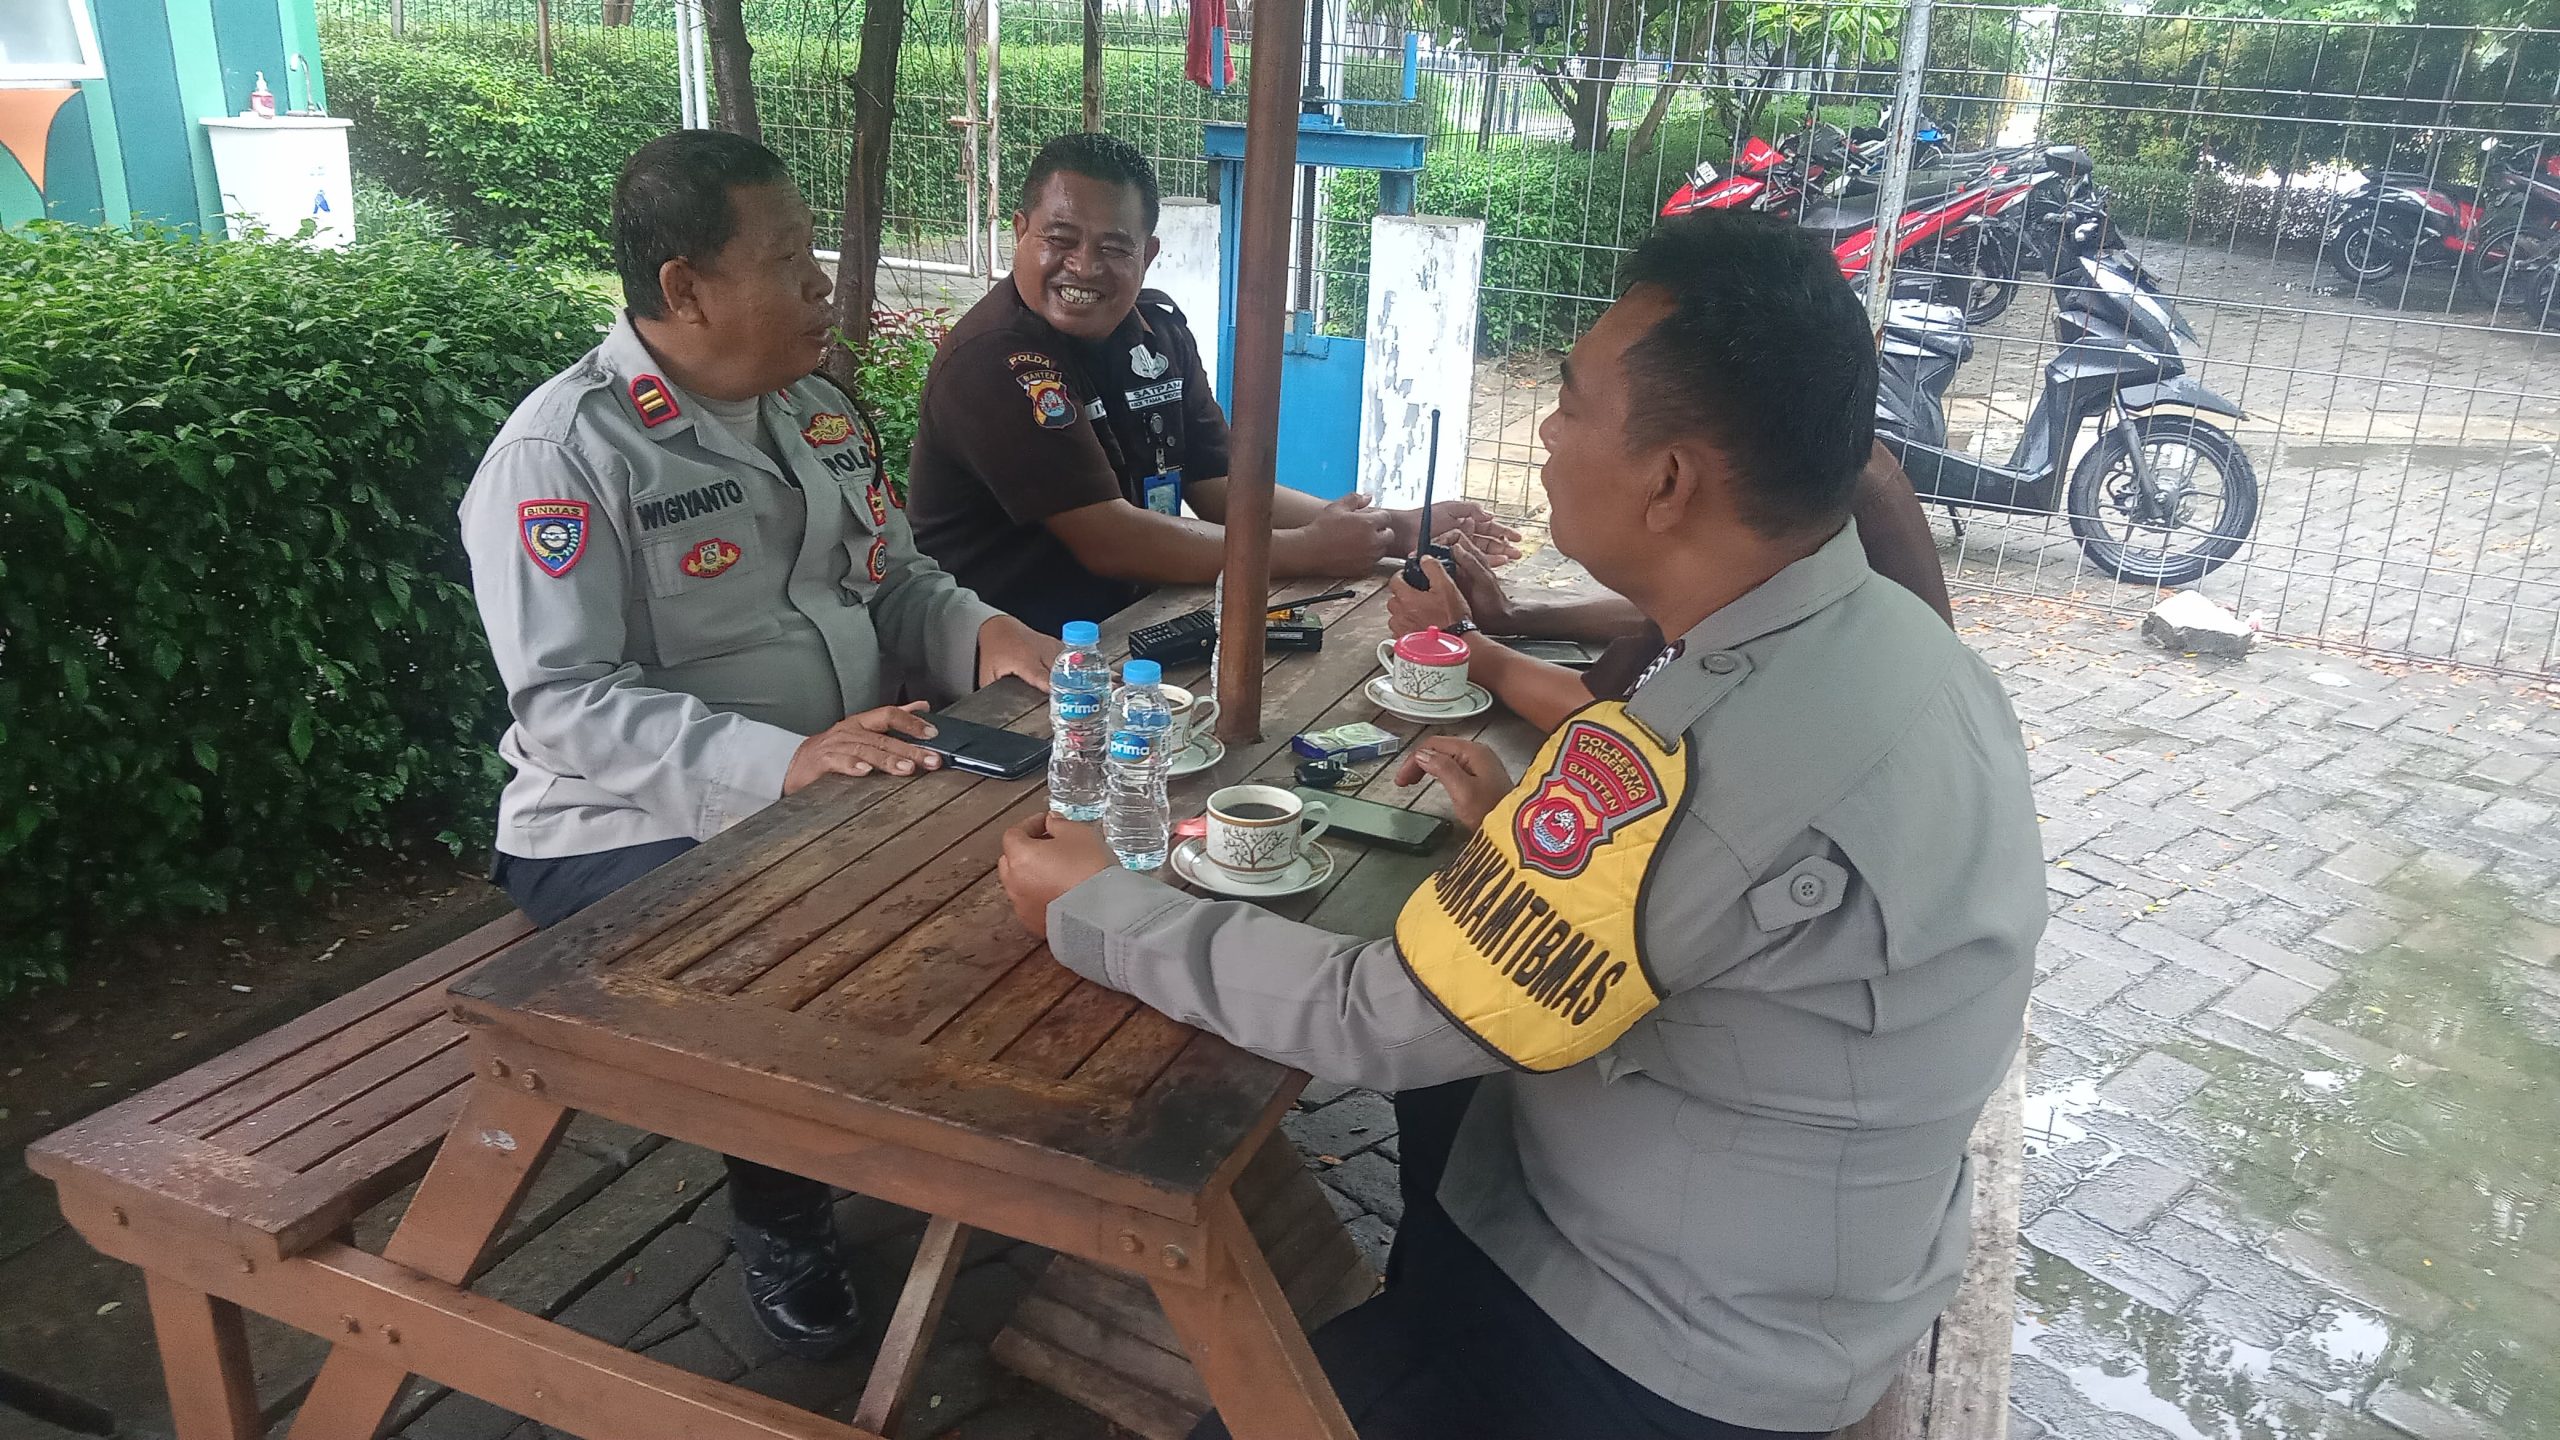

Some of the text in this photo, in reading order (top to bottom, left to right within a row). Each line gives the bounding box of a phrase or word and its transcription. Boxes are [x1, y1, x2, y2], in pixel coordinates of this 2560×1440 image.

[1009, 354, 1050, 369] POLDA
[1023, 371, 1056, 382] BANTEN
[527, 507, 581, 516] BINMAS
[637, 479, 743, 531] WIGIYANTO
[1059, 702, 1100, 714] prima
[1110, 741, 1150, 756] prima
[1577, 743, 1640, 801] TANGERANG
[1578, 733, 1649, 799] POLRESTA
[1567, 762, 1619, 811] BANTEN
